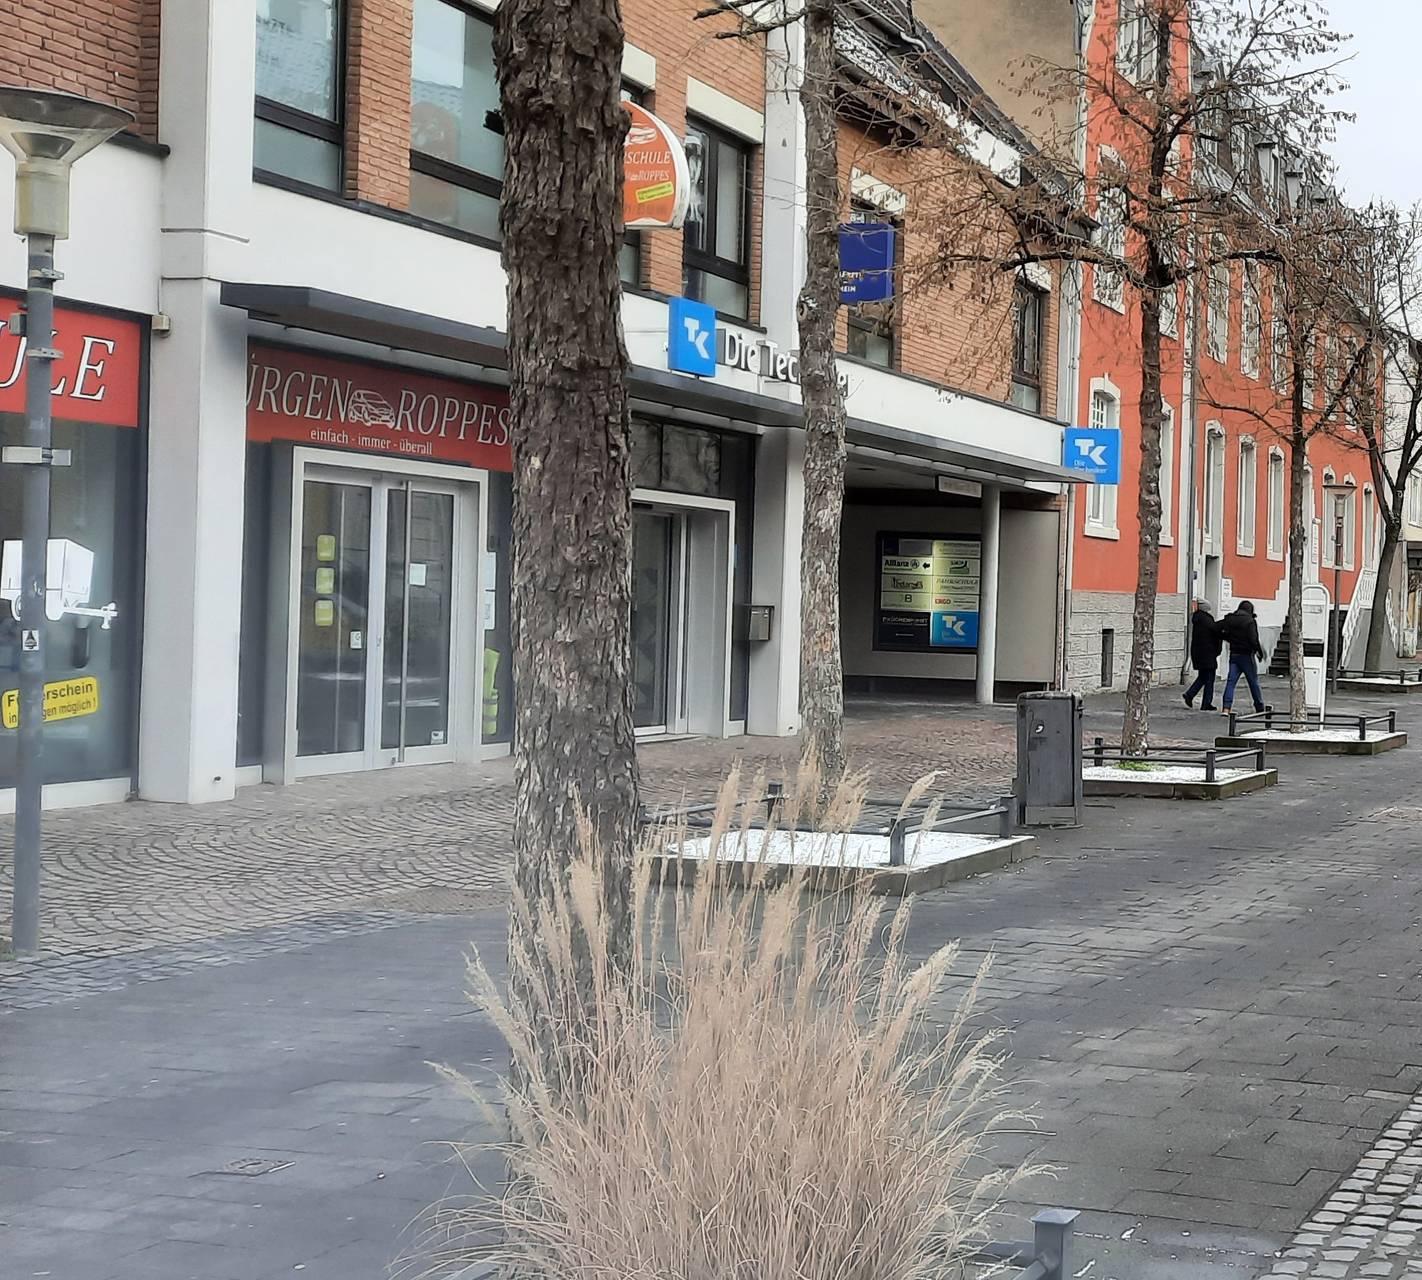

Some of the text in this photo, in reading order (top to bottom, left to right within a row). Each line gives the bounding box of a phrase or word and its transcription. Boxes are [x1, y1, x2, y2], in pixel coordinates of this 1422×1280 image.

[725, 331, 760, 374] Die
[396, 389, 512, 447] ROPPES
[310, 427, 350, 445] einfach
[357, 434, 392, 451] immer
[399, 438, 433, 456] überall
[884, 559, 910, 568] Allianz
